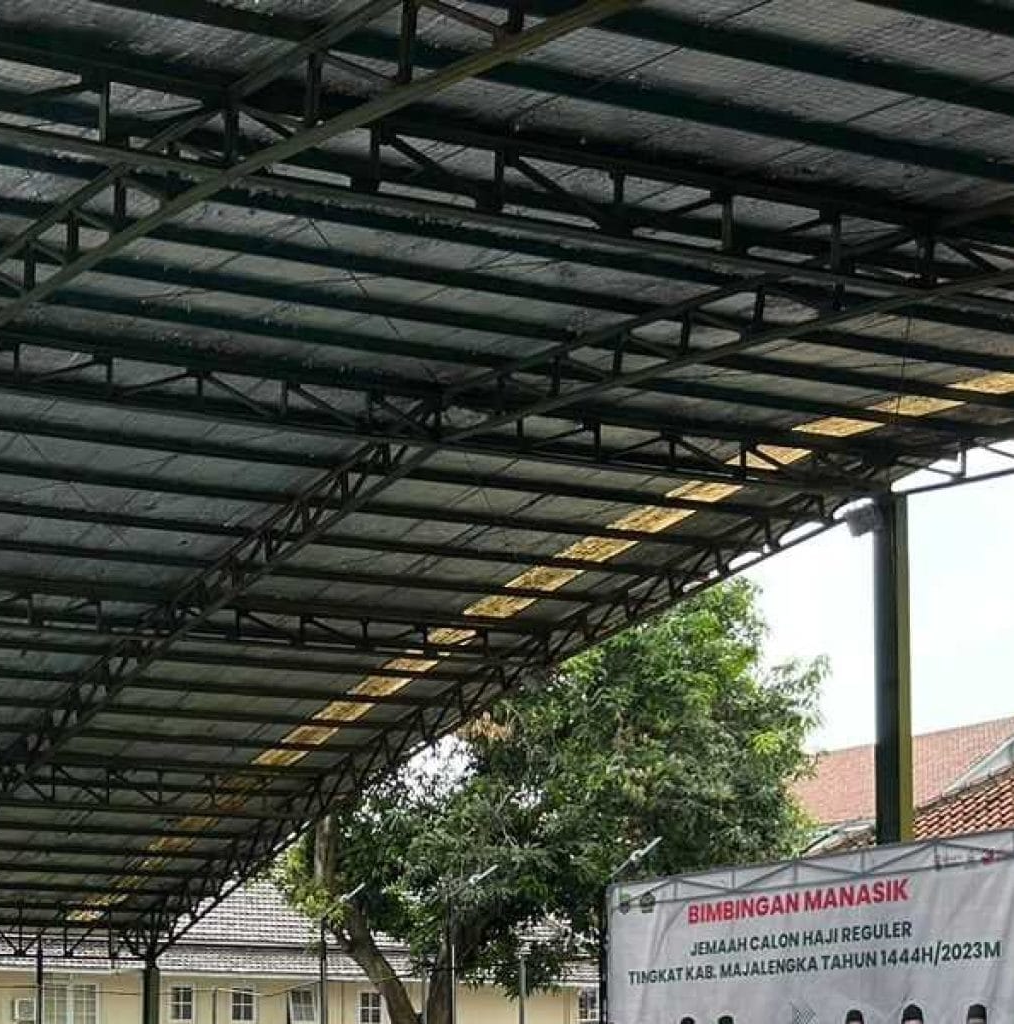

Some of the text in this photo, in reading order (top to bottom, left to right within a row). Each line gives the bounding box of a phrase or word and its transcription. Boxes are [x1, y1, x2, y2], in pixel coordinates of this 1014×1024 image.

[687, 878, 908, 924] BIMBINGAN MANASIK
[690, 921, 912, 956] JEMAAH CALON HAJI REGULER
[628, 967, 683, 985] TINGKAT
[686, 964, 716, 981] KAB.
[719, 955, 818, 978] MAJALENGKA
[821, 951, 876, 970] TAHUN
